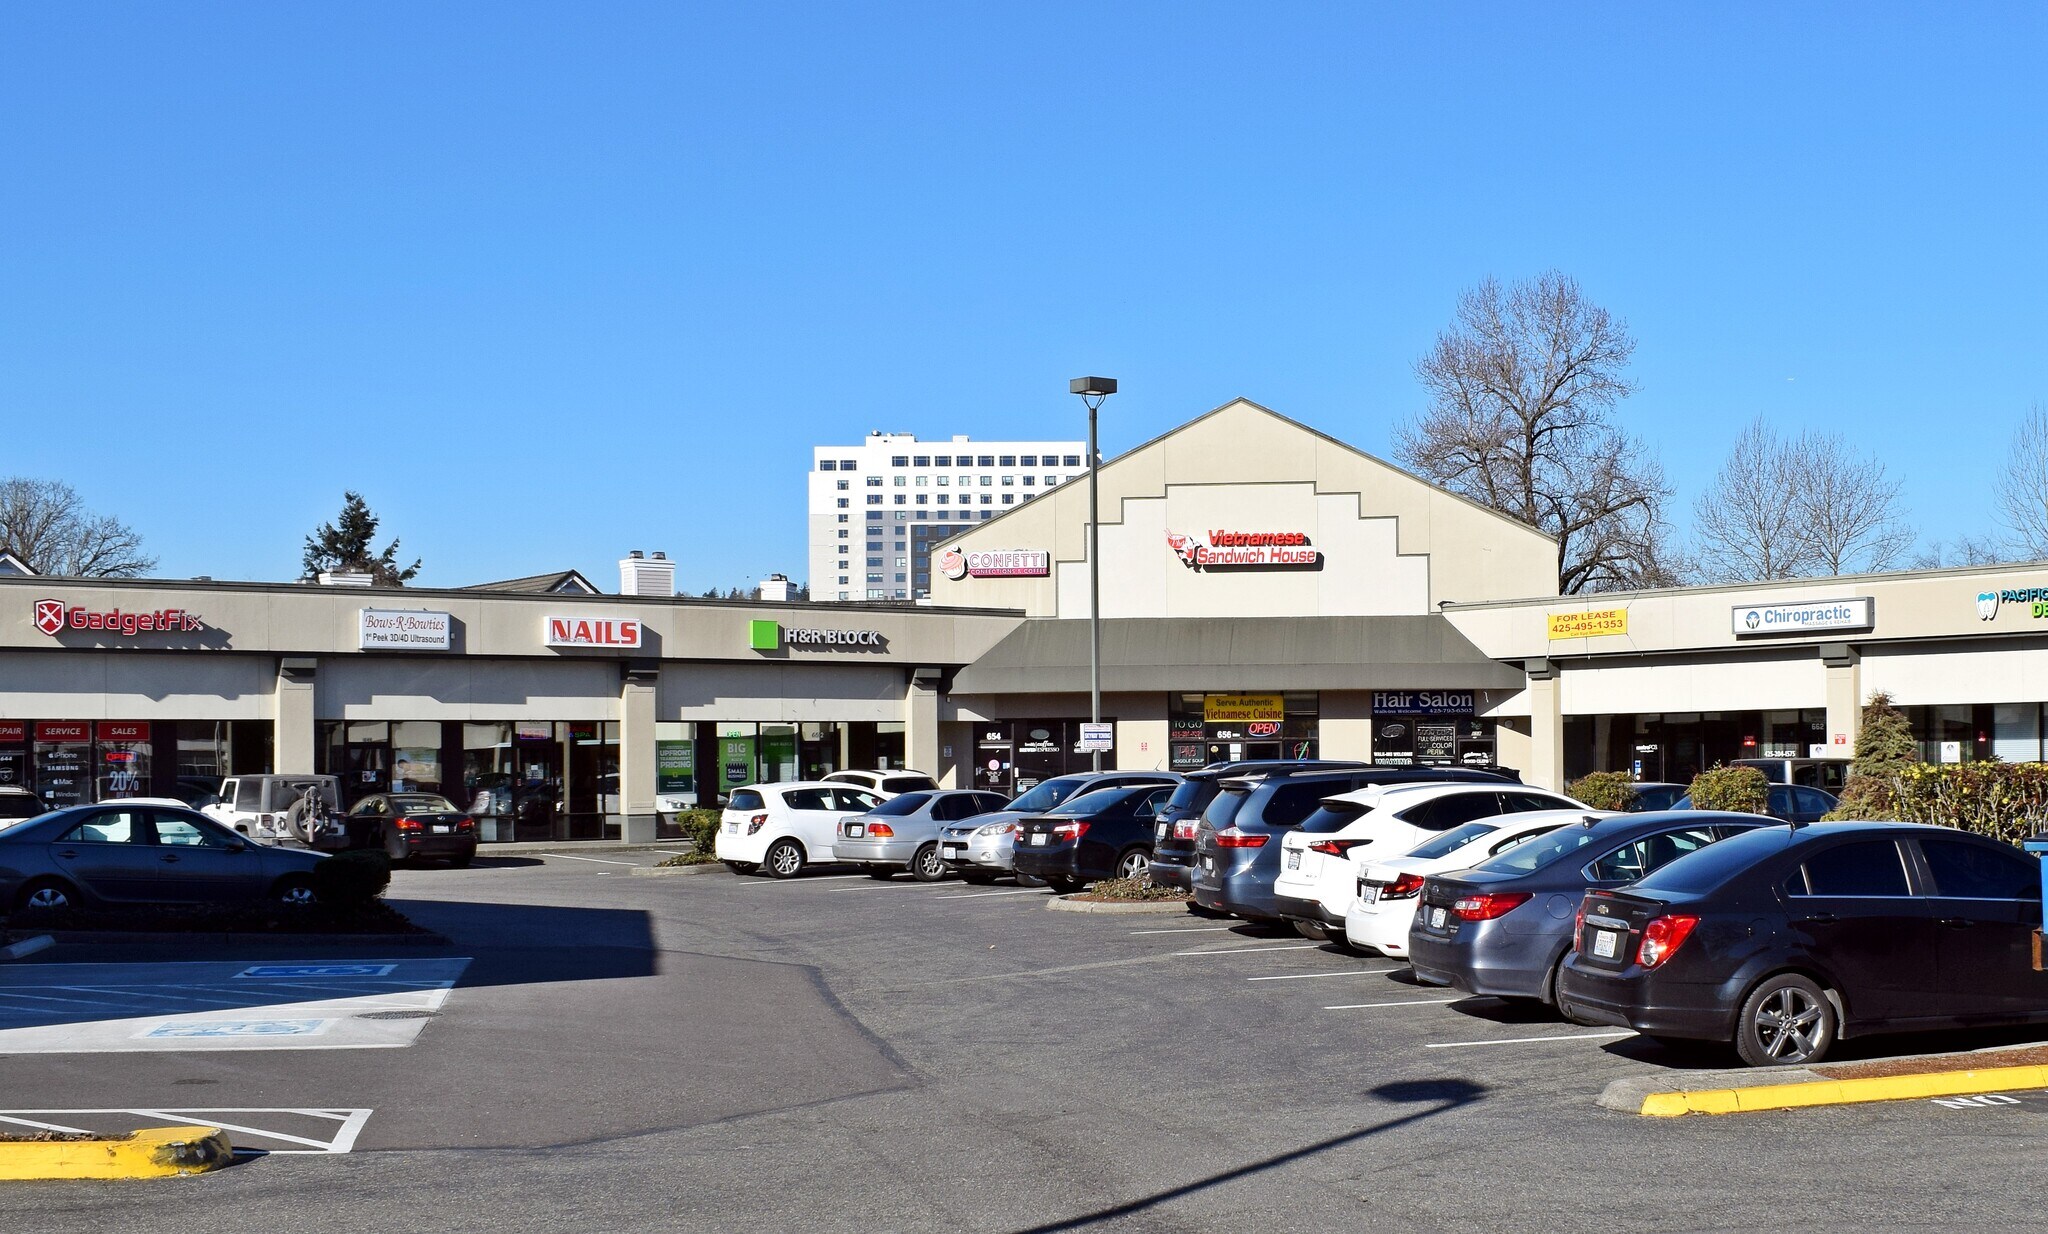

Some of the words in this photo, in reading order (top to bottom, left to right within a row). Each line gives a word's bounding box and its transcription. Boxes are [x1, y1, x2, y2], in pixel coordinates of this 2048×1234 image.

[1208, 529, 1305, 546] Vietnamese
[969, 553, 1046, 568] CONFETTI
[1198, 548, 1265, 564] Sandwich
[1270, 548, 1316, 563] House
[69, 607, 203, 635] GadgetFix
[1556, 614, 1578, 622] FOR
[1581, 611, 1616, 621] LEASE
[1764, 605, 1851, 625] Chiropractic
[365, 615, 445, 632] Bows-R-Bowties
[1552, 620, 1623, 633] 425-495-1353
[372, 633, 389, 642] Peek
[390, 634, 409, 642] 3D/4D
[410, 634, 445, 644] Ultrasound
[552, 620, 637, 644] NAILS
[784, 628, 822, 643] H&R
[825, 629, 880, 645] BLOCK
[1239, 699, 1273, 707] Authentic
[1373, 692, 1413, 708] Hair
[1418, 692, 1473, 708] Salon
[1205, 709, 1251, 719] Vietnamese
[1253, 709, 1282, 719] Cuisine
[45, 727, 81, 735] SERVICE
[111, 727, 137, 735] SALES
[1174, 720, 1186, 728] TO
[1187, 720, 1203, 728] GO
[1249, 722, 1278, 734] OPEN
[986, 732, 1001, 740] 654
[727, 743, 746, 753] BIG
[106, 753, 135, 761] OPEN
[109, 771, 140, 791] 20%
[1931, 1094, 2022, 1110] NO
